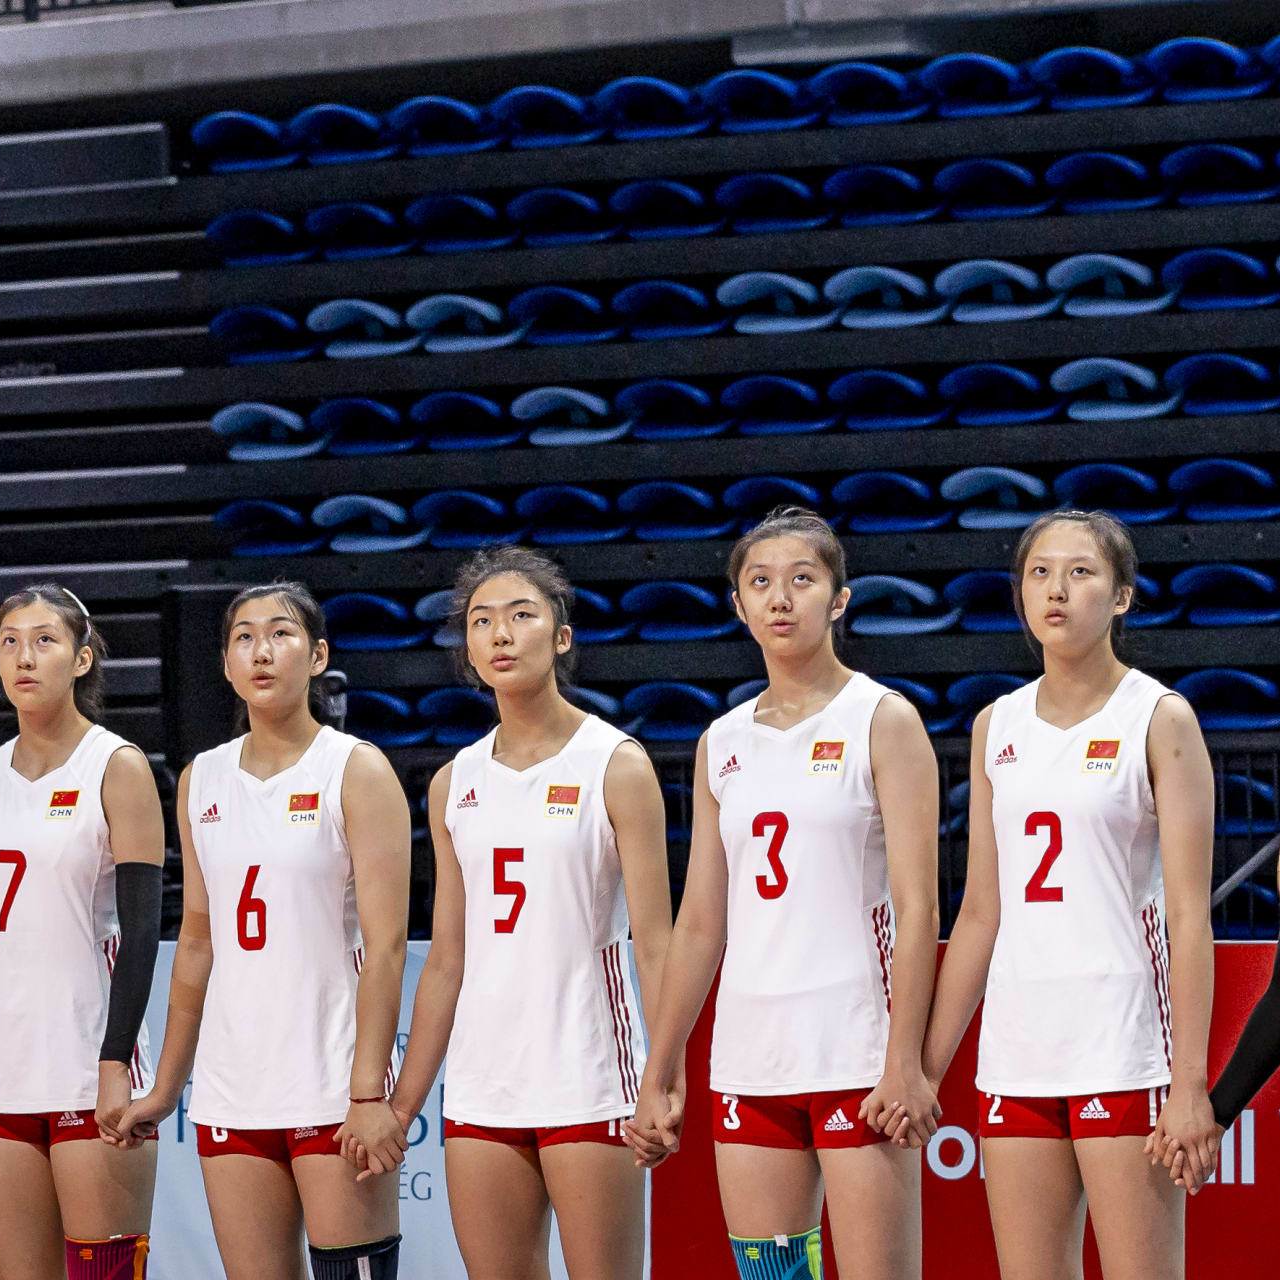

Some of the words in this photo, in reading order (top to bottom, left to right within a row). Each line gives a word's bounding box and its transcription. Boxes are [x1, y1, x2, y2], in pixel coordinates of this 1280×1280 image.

[995, 756, 1018, 766] adidas
[1086, 761, 1112, 771] CHN
[813, 762, 838, 773] CHN
[49, 808, 72, 817] CHN
[548, 806, 574, 816] CHN
[291, 812, 315, 823] CHN
[751, 811, 789, 900] 3
[1024, 810, 1064, 903] 2
[493, 847, 527, 934] 5
[236, 864, 267, 951] 6
[722, 1094, 741, 1130] 3
[986, 1093, 1004, 1124] 2
[1079, 1110, 1111, 1120] adidas
[824, 1121, 855, 1131] adidas
